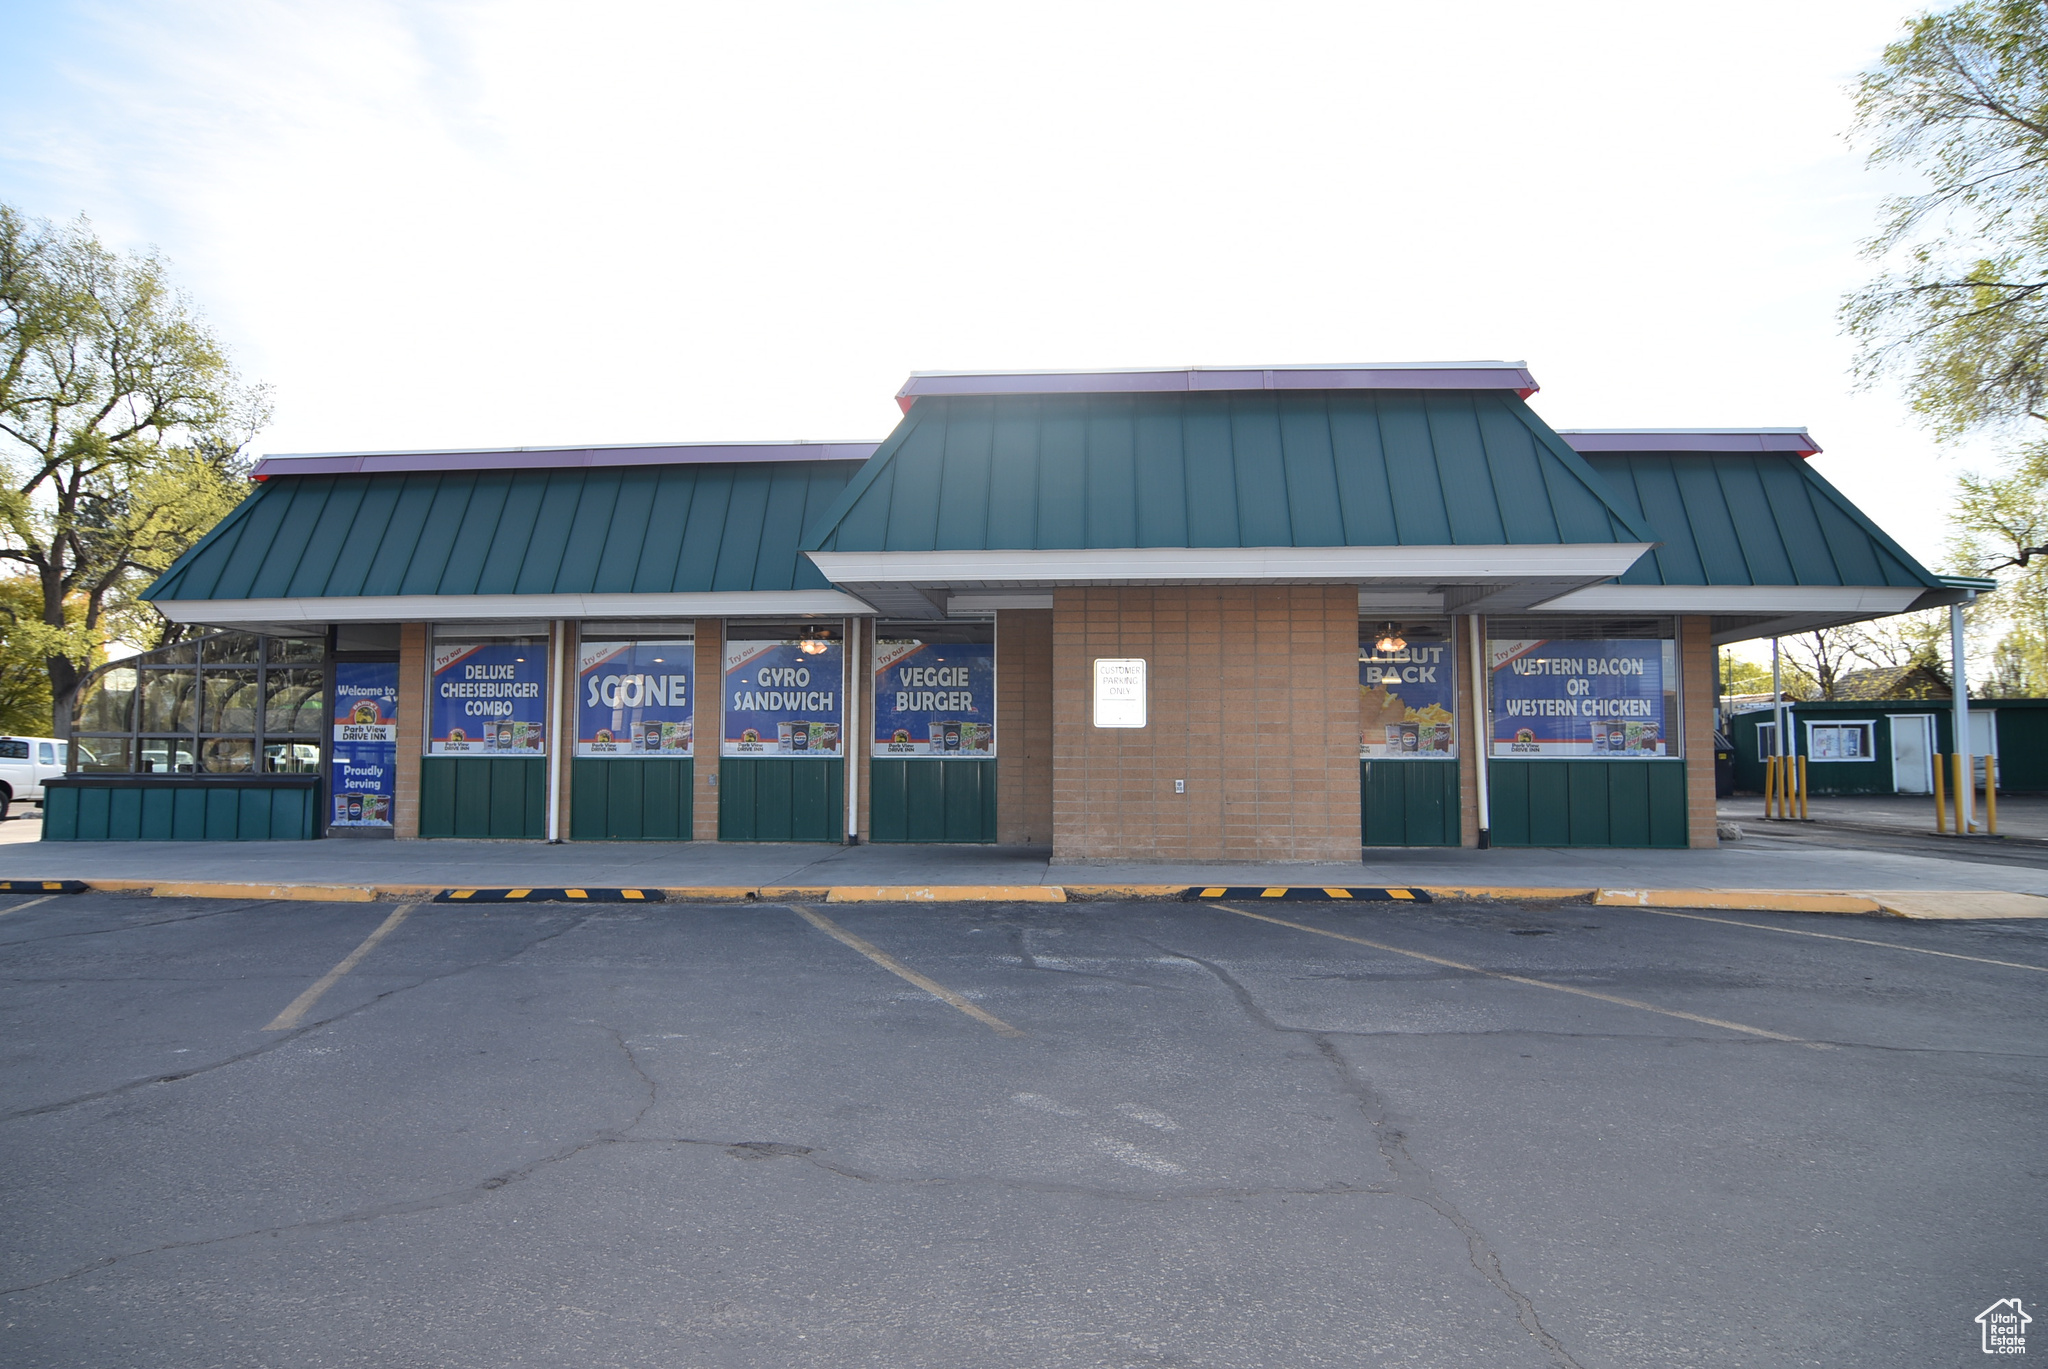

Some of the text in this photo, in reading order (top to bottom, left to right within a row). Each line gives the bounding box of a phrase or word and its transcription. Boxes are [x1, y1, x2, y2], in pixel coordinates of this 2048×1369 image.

[436, 648, 462, 665] Try our
[582, 648, 608, 666] Try our
[728, 646, 755, 665] Try our
[878, 646, 904, 664] Try our
[1494, 642, 1523, 660] Try our
[465, 665, 515, 680] DELUXE
[1100, 666, 1140, 674] CUSTOMER
[1512, 658, 1643, 675] WESTERN BACON
[758, 668, 810, 688] GYRO
[900, 667, 969, 687] VEGGIE
[1366, 667, 1436, 684] BACK
[338, 685, 396, 696] Welcome to
[440, 683, 539, 698] CHEESEBURGER
[587, 675, 686, 708] SCONE
[1567, 679, 1590, 696] OR
[465, 701, 513, 716] COMBO
[734, 691, 833, 712] SANDWICH
[896, 691, 972, 712] BURGER
[1506, 699, 1651, 716] WESTERN CHICKEN
[344, 765, 383, 778] Proudly
[344, 778, 381, 790] Serving
